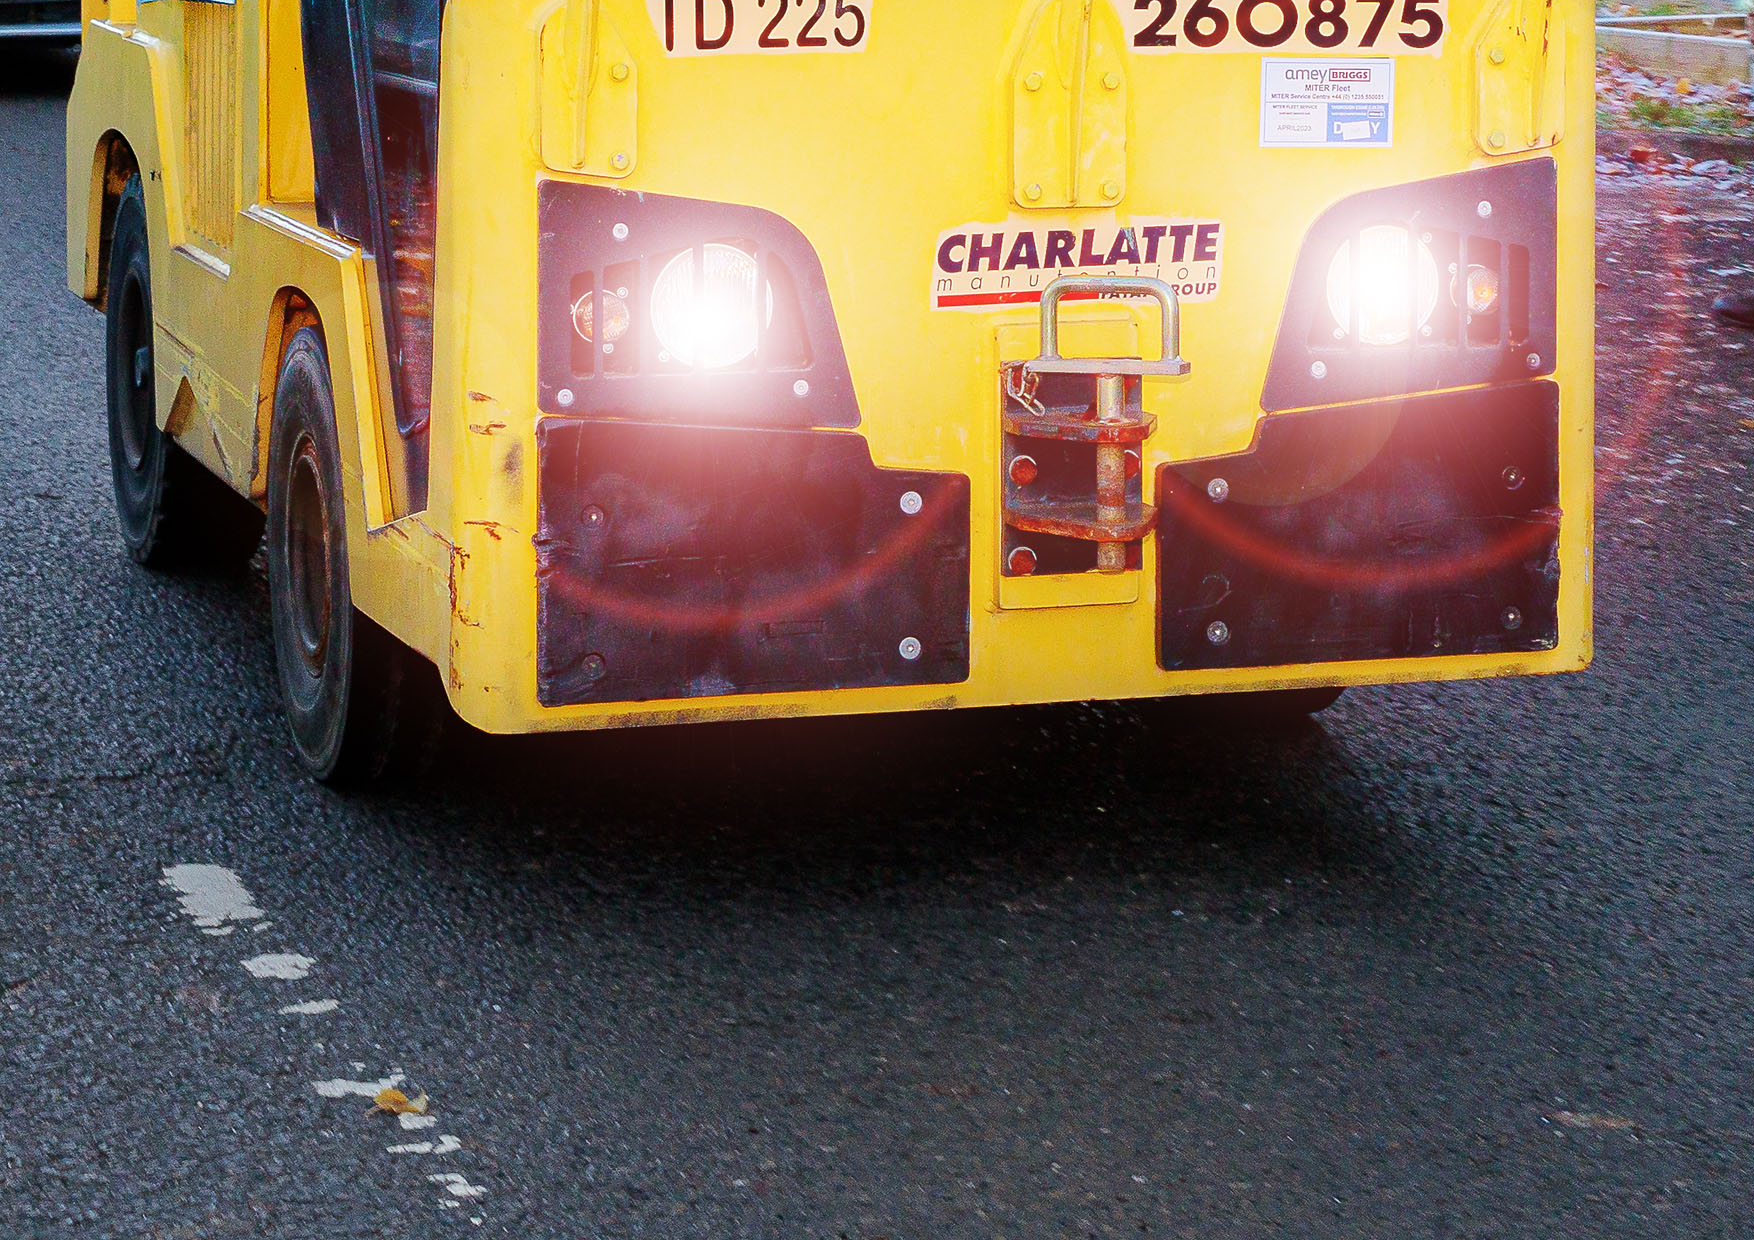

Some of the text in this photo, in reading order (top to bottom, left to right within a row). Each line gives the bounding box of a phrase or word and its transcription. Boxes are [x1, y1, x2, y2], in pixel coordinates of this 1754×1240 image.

[1285, 68, 1369, 84] amey BRIGGS
[1305, 84, 1351, 92] MITER Fleet
[937, 223, 1221, 273] CHARLATTE
[937, 265, 1217, 292] manutntion
[1170, 282, 1217, 296] ROUP
